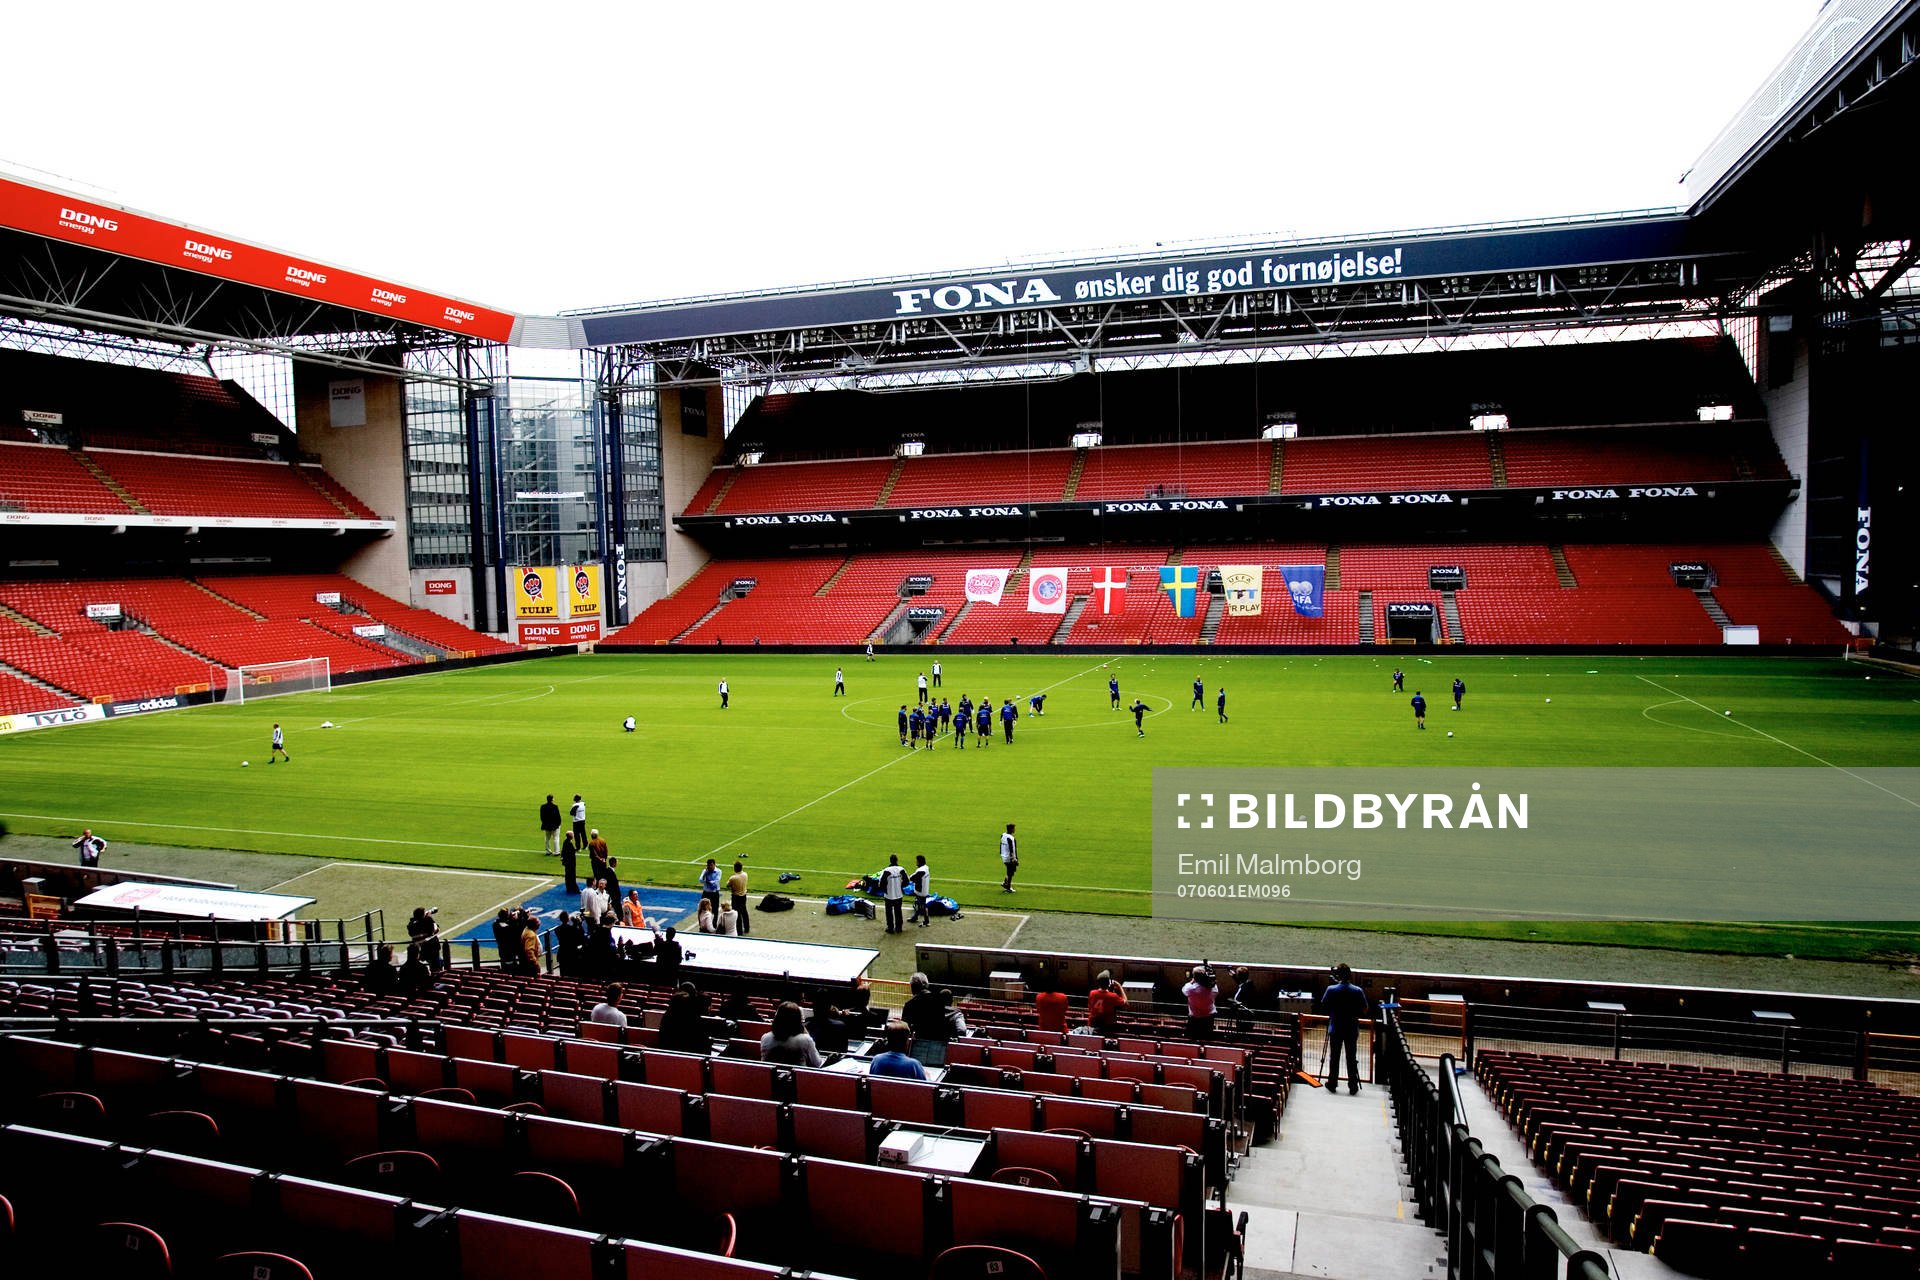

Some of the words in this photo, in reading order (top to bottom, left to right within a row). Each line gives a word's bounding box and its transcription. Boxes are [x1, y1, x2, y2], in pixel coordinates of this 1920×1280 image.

[60, 208, 118, 231] DONG
[59, 220, 95, 234] energy
[185, 240, 232, 260] DONG
[184, 251, 213, 263] energy
[285, 276, 310, 287] energy
[287, 266, 327, 284] DONG
[893, 278, 1061, 314] FONA
[1075, 270, 1156, 300] ønsker
[1162, 266, 1199, 294] dig
[1207, 261, 1253, 292] god
[1261, 248, 1402, 284] fornøjelse!
[371, 297, 392, 307] energy
[372, 288, 406, 304] DONG
[445, 307, 475, 321] DONG
[1320, 496, 1381, 506] FONA
[1390, 494, 1453, 504] FONA
[1552, 489, 1619, 500] FONA
[1628, 487, 1698, 498] FONA
[910, 509, 963, 518] FONA
[969, 507, 1023, 516] FONA
[1106, 502, 1163, 512] FONA
[1170, 500, 1228, 510] FONA
[735, 517, 782, 525] FONA
[787, 514, 836, 523] FONA
[1855, 507, 1871, 595] FONA
[615, 544, 627, 610] FONA
[521, 606, 553, 614] TULIP
[574, 604, 597, 613] TULIP
[1239, 604, 1260, 612] PLAY
[524, 627, 560, 635] DONG
[570, 624, 596, 634] DONG
[139, 697, 178, 711] adidas
[27, 708, 87, 727] TYLÖ
